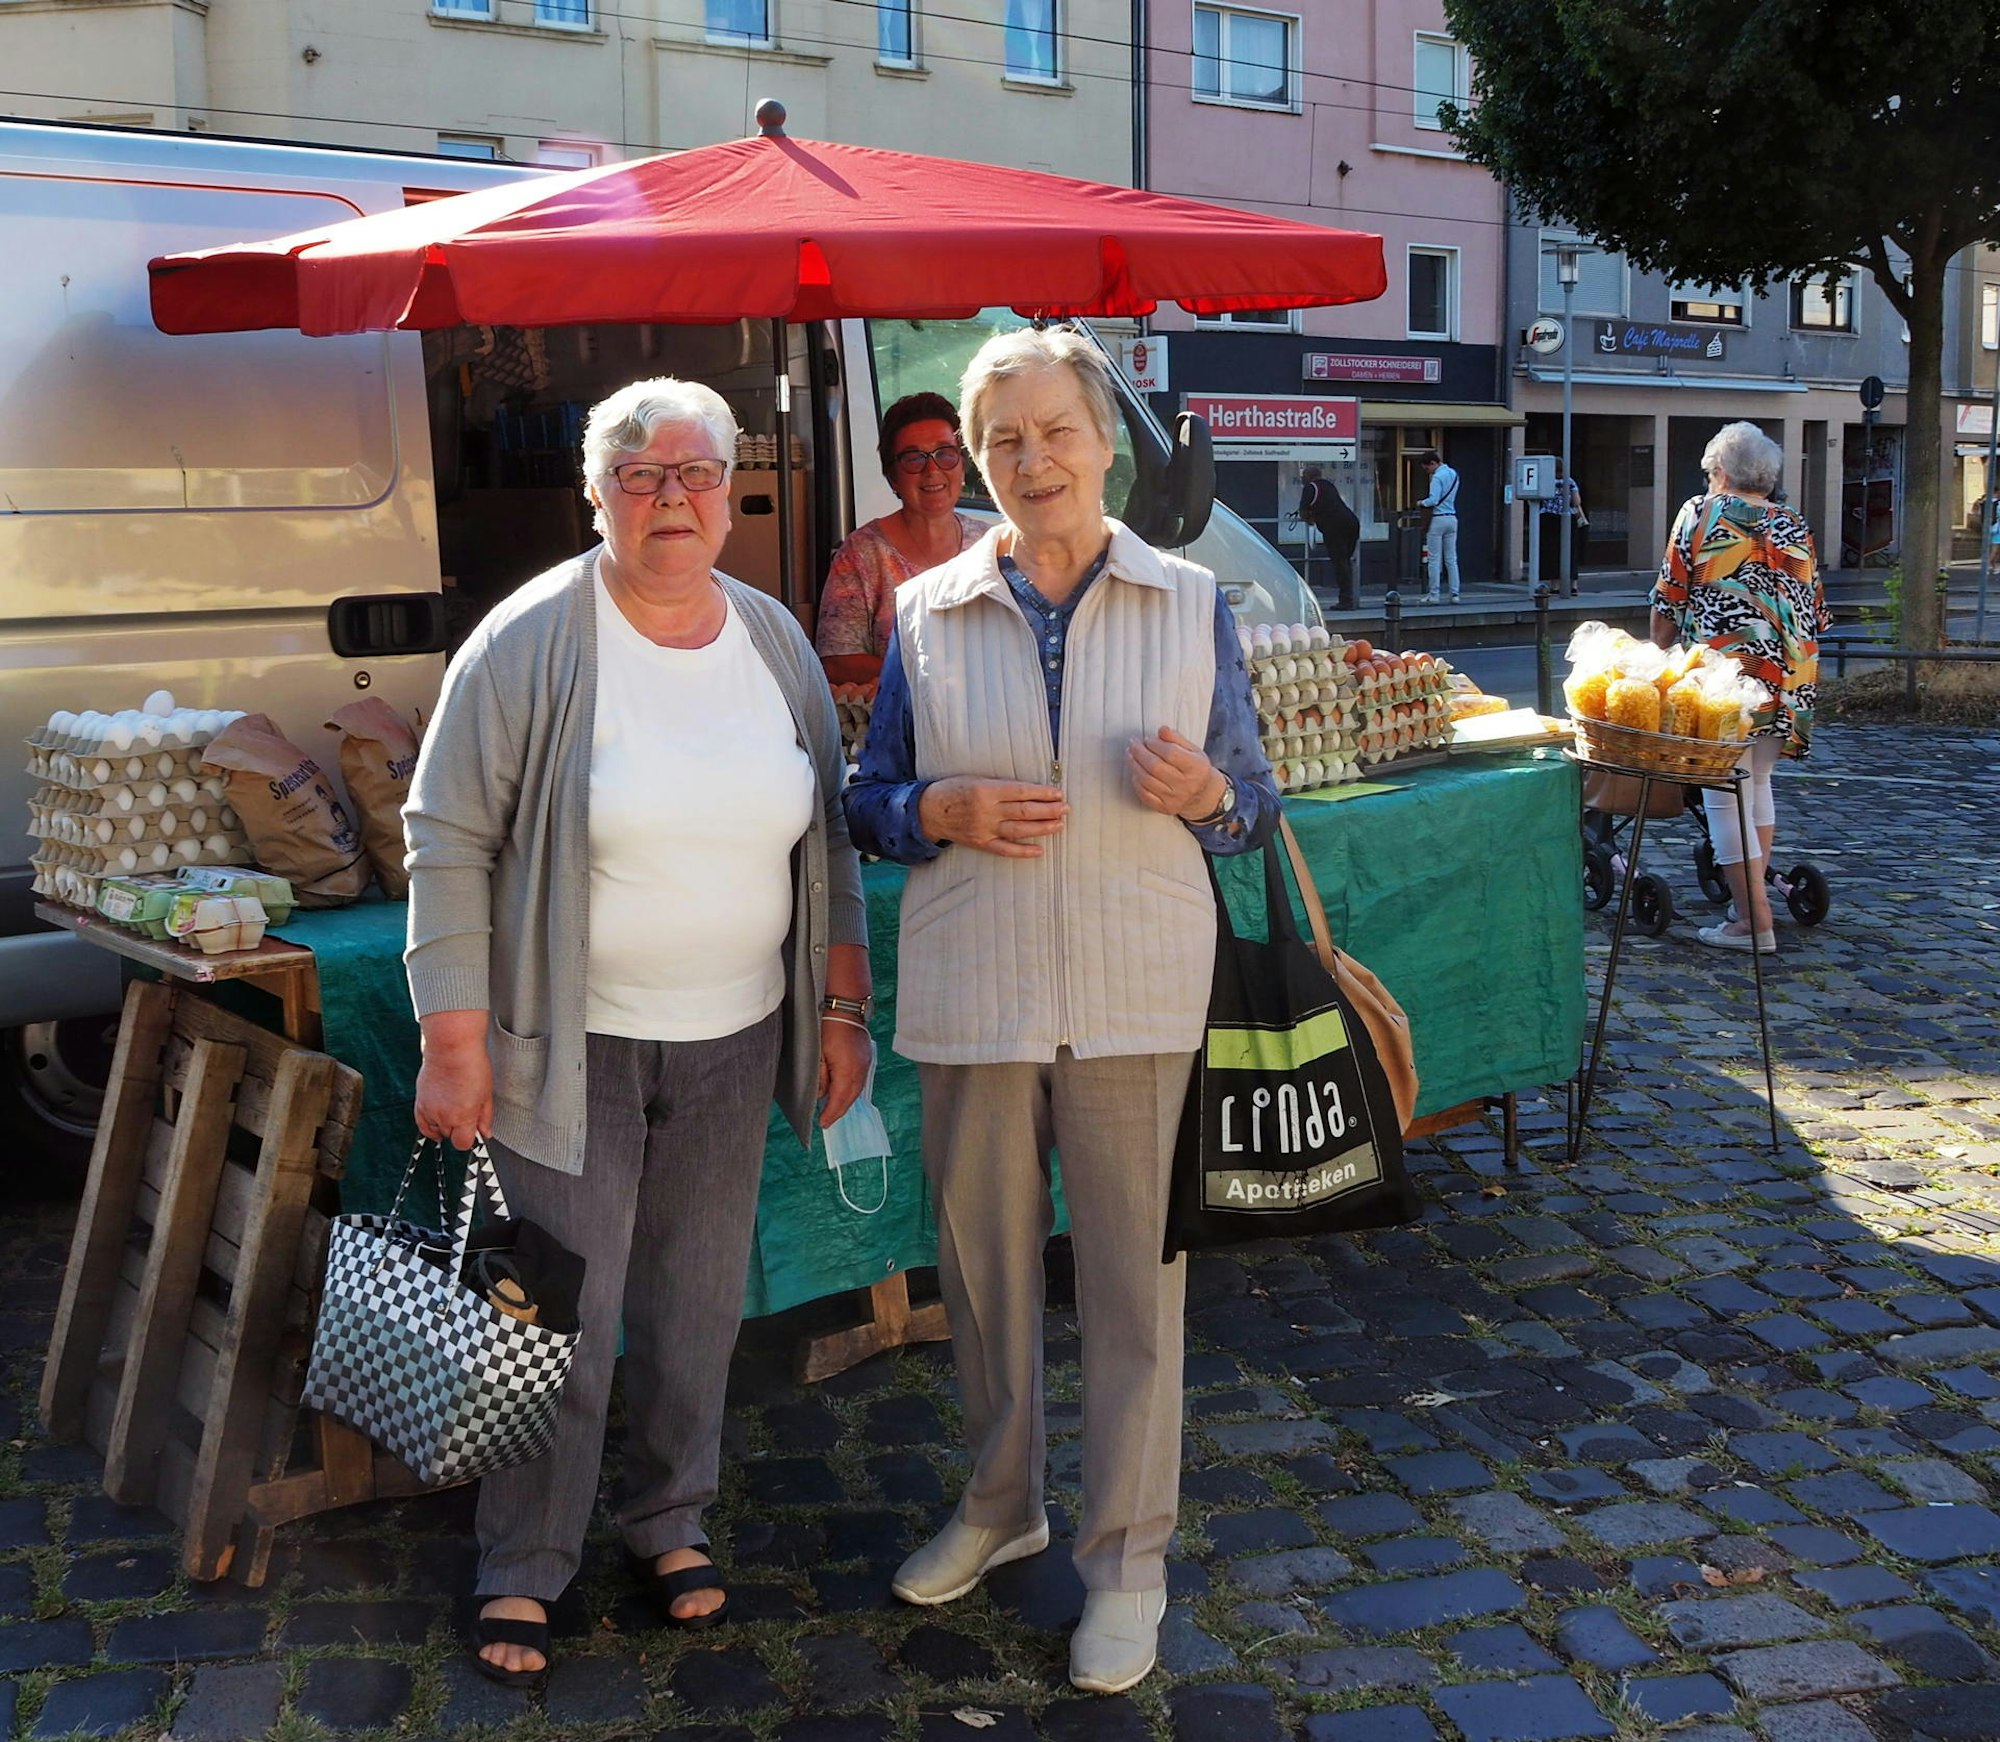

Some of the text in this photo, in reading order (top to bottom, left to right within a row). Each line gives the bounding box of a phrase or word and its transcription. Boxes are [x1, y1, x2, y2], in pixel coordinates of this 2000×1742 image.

[1623, 326, 1648, 351] Café
[1330, 358, 1422, 370] ZOLLSTOCKER SCHNEIDEREI
[1132, 378, 1156, 388] IOSK
[1208, 404, 1337, 429] Herthastraße
[1527, 467, 1535, 486] F
[1225, 1161, 1357, 1204] Apotheken
